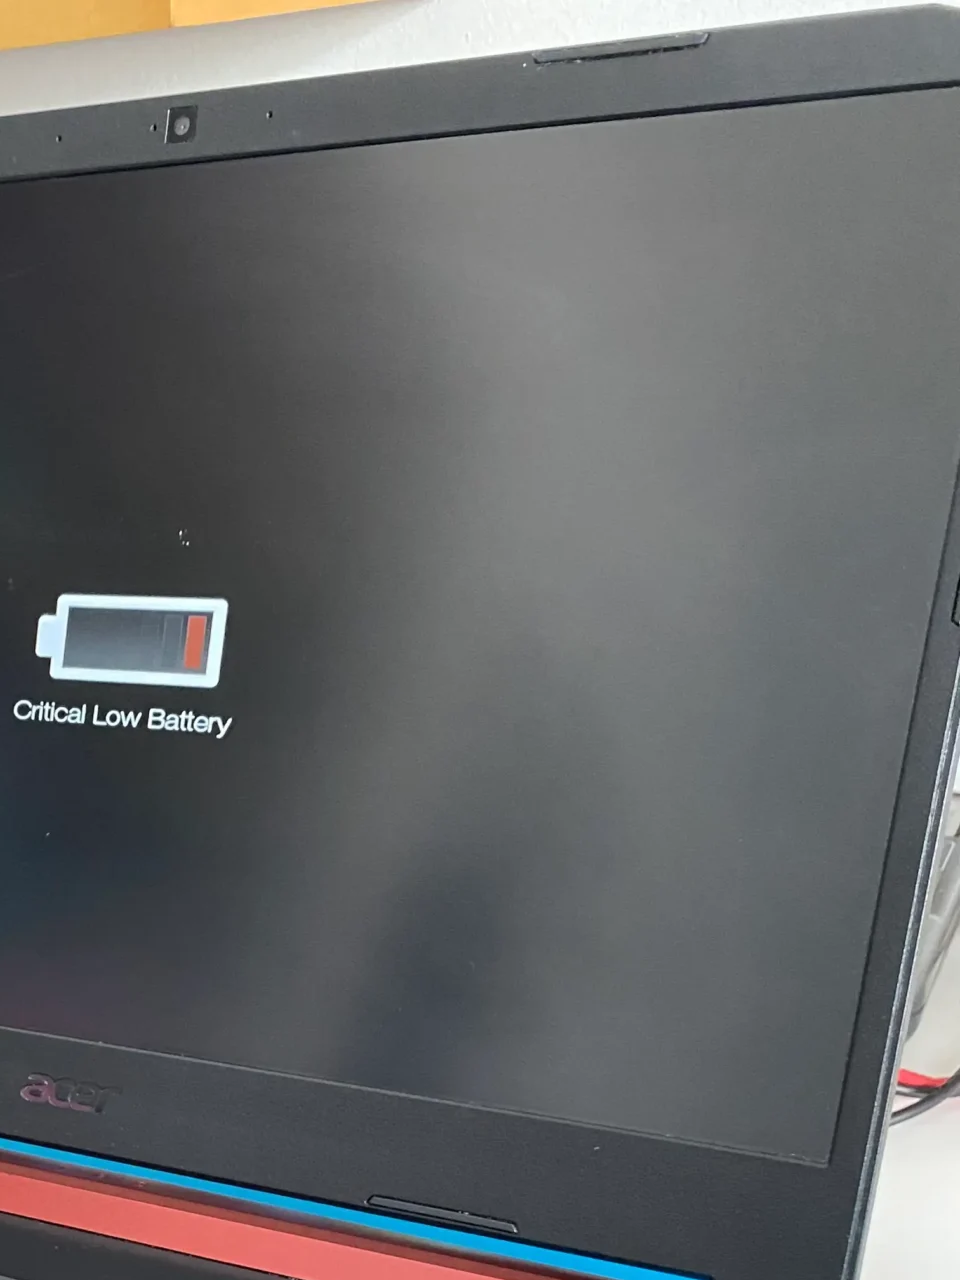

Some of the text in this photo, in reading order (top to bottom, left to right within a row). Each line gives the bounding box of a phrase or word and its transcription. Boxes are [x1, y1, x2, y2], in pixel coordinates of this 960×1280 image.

[13, 699, 233, 739] Critical Low Battery
[20, 1072, 123, 1113] acer
